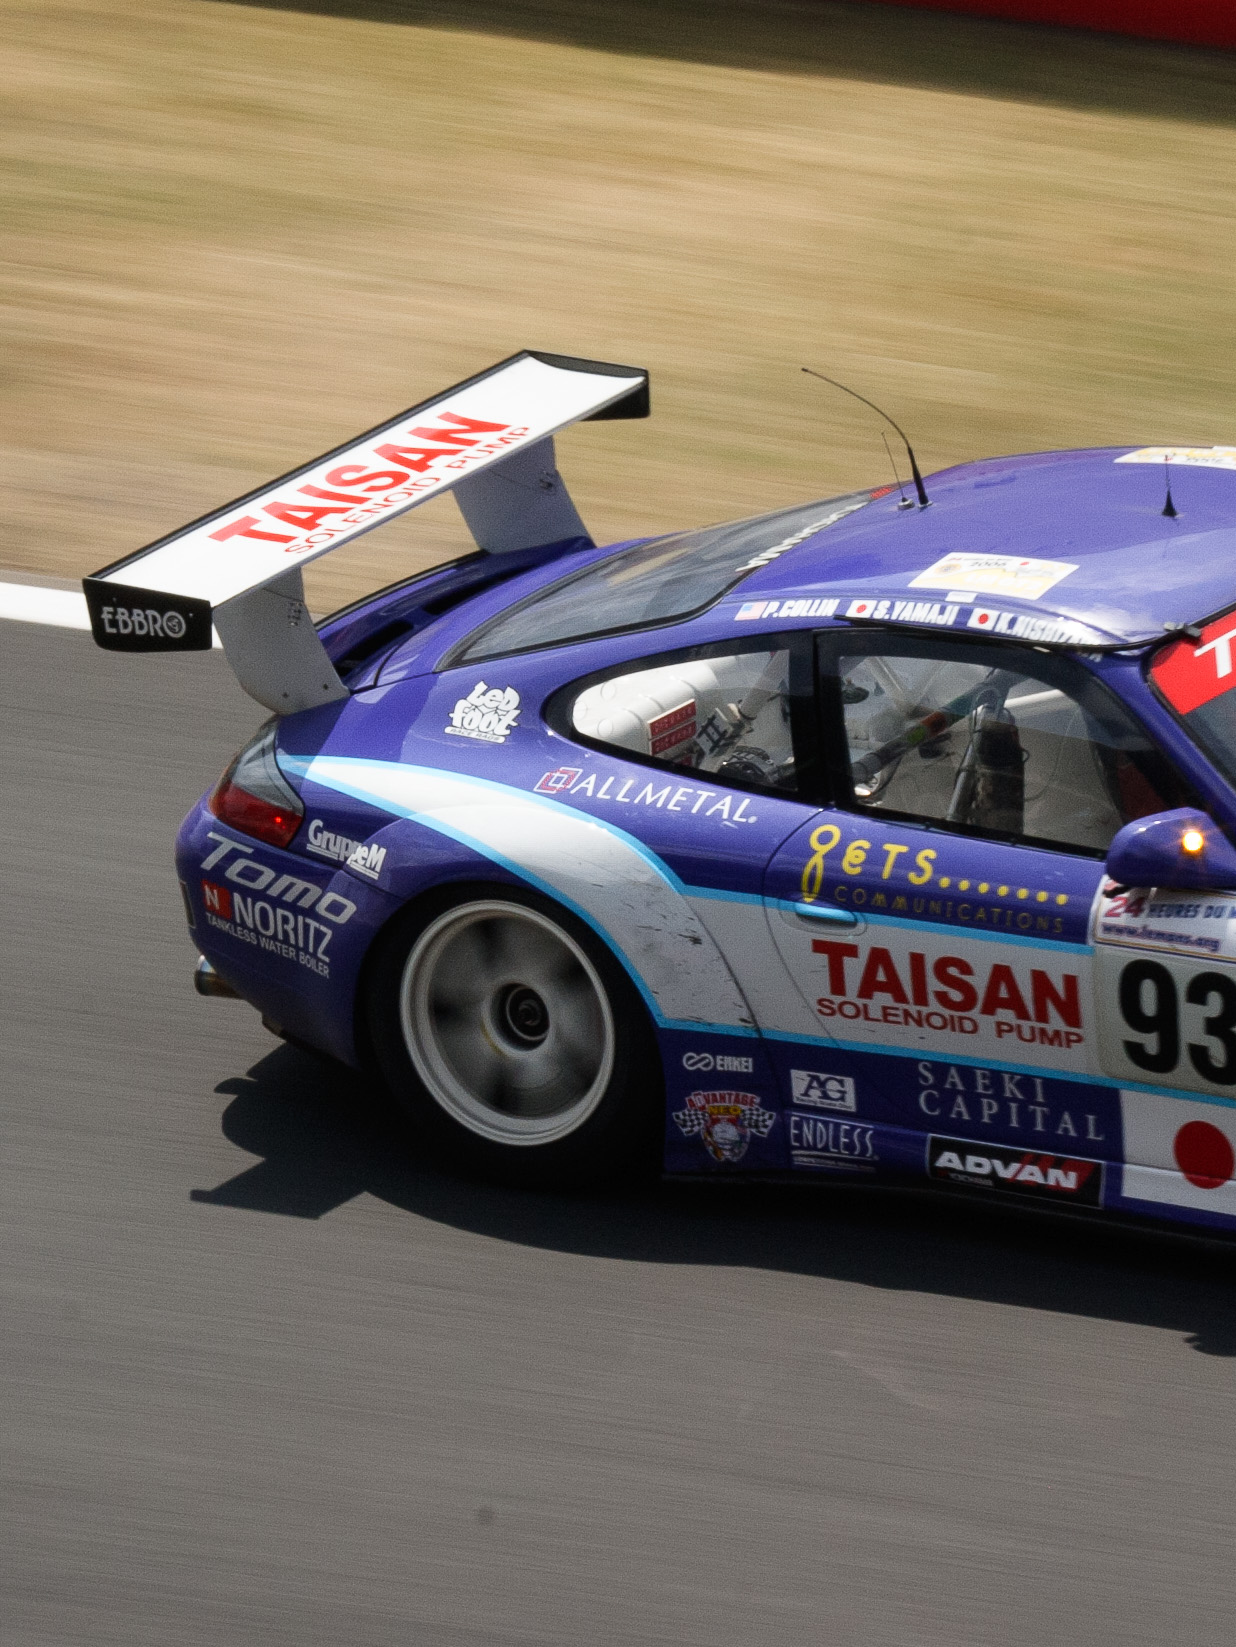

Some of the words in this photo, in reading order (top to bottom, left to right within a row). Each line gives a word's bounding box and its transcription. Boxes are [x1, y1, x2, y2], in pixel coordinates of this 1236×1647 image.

[208, 412, 512, 547] TAISAN
[284, 476, 441, 555] SOLENOID
[457, 426, 531, 471] PUMP
[873, 600, 960, 626] S.YAMAJI
[570, 773, 754, 824] ALLMETAL
[233, 892, 333, 963] NORITZ
[834, 886, 1064, 934] COMMUNICATIONS
[1104, 895, 1147, 918] 24
[1148, 903, 1201, 919] HEURES
[1202, 903, 1228, 919] DU
[206, 912, 257, 945] TANKLESS
[258, 935, 297, 961] WATER
[298, 951, 330, 979] BOILER
[811, 938, 1083, 1029] TAISAN
[816, 997, 980, 1035] SOLENOID
[995, 1020, 1085, 1049] PUMP
[686, 1091, 760, 1112] ADVANTAGE
[917, 1061, 1046, 1103] SAEKI
[708, 1105, 742, 1116] NEO
[918, 1089, 1106, 1141] CAPITAL
[790, 1116, 875, 1158] ENDLESS
[934, 1151, 1079, 1189] ADVAN
